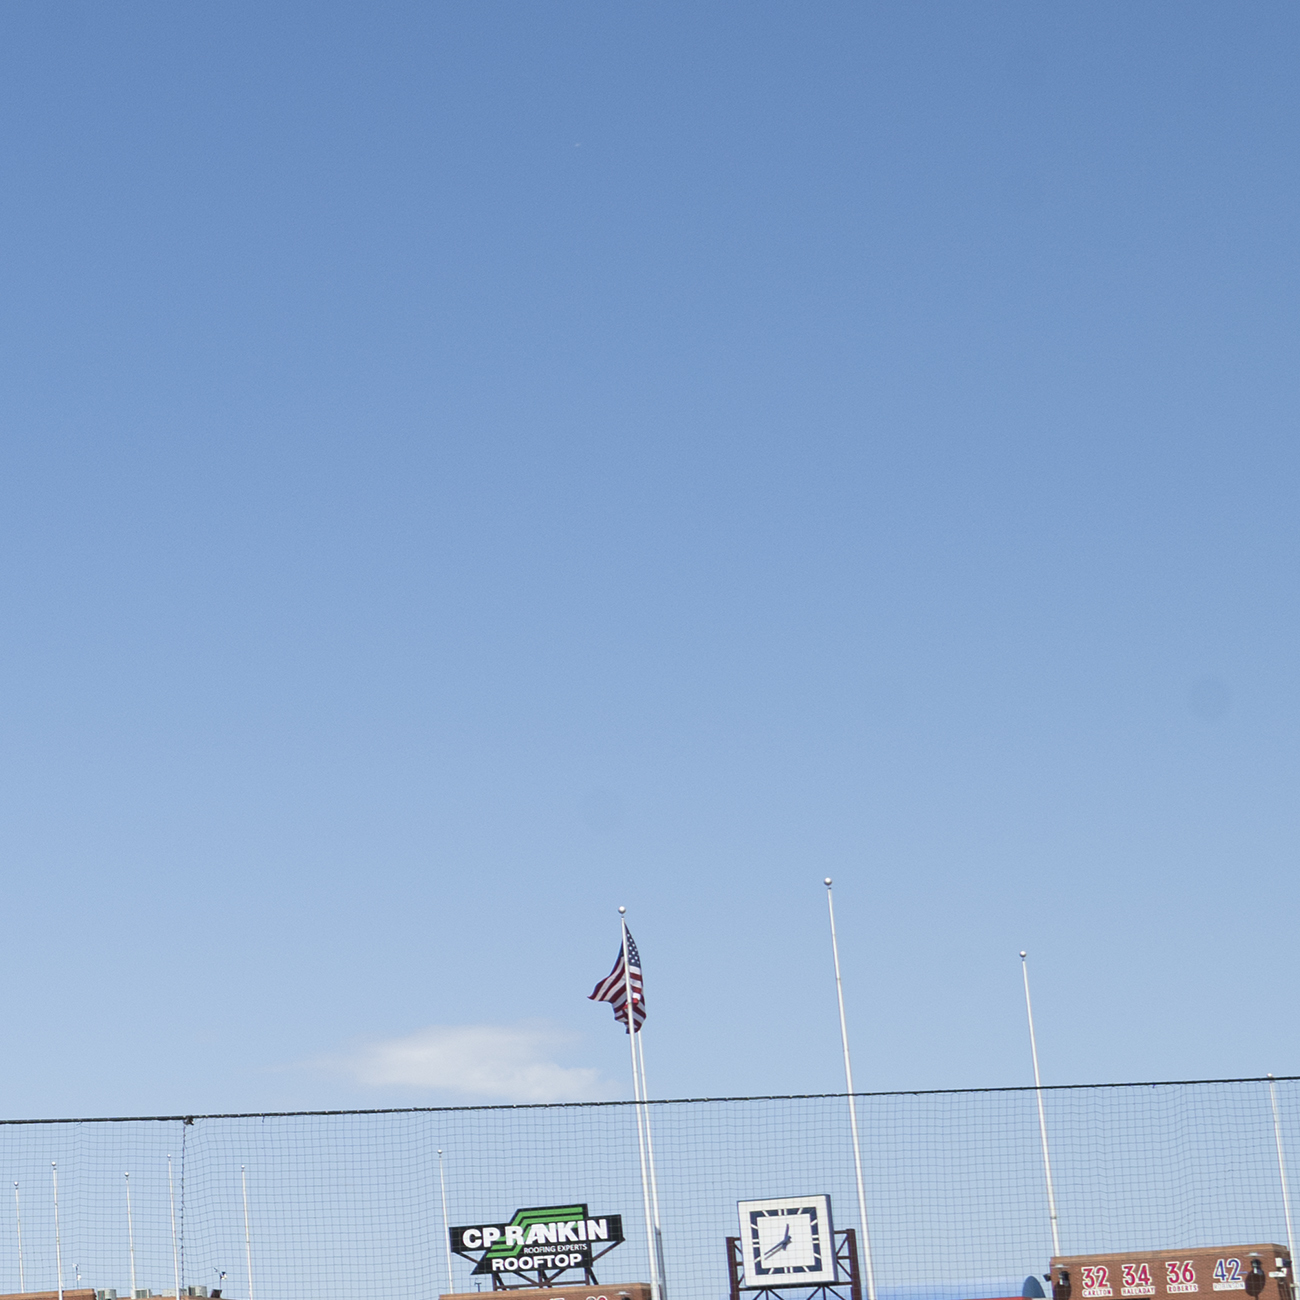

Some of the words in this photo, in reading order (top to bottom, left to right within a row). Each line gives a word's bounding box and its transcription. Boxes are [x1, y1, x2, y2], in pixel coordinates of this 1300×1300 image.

[462, 1227, 500, 1248] CP
[504, 1218, 608, 1246] RANKIN
[524, 1246, 555, 1254] ROOFING
[557, 1243, 587, 1251] EXPERTS
[492, 1253, 582, 1271] ROOFTOP
[1213, 1258, 1241, 1282] 42
[1082, 1266, 1110, 1289] 32
[1122, 1264, 1151, 1287] 34
[1166, 1261, 1195, 1285] 36
[1083, 1289, 1111, 1297] CARLTON
[1122, 1287, 1154, 1295] HALLADAY
[1168, 1285, 1197, 1293] ROBERTS
